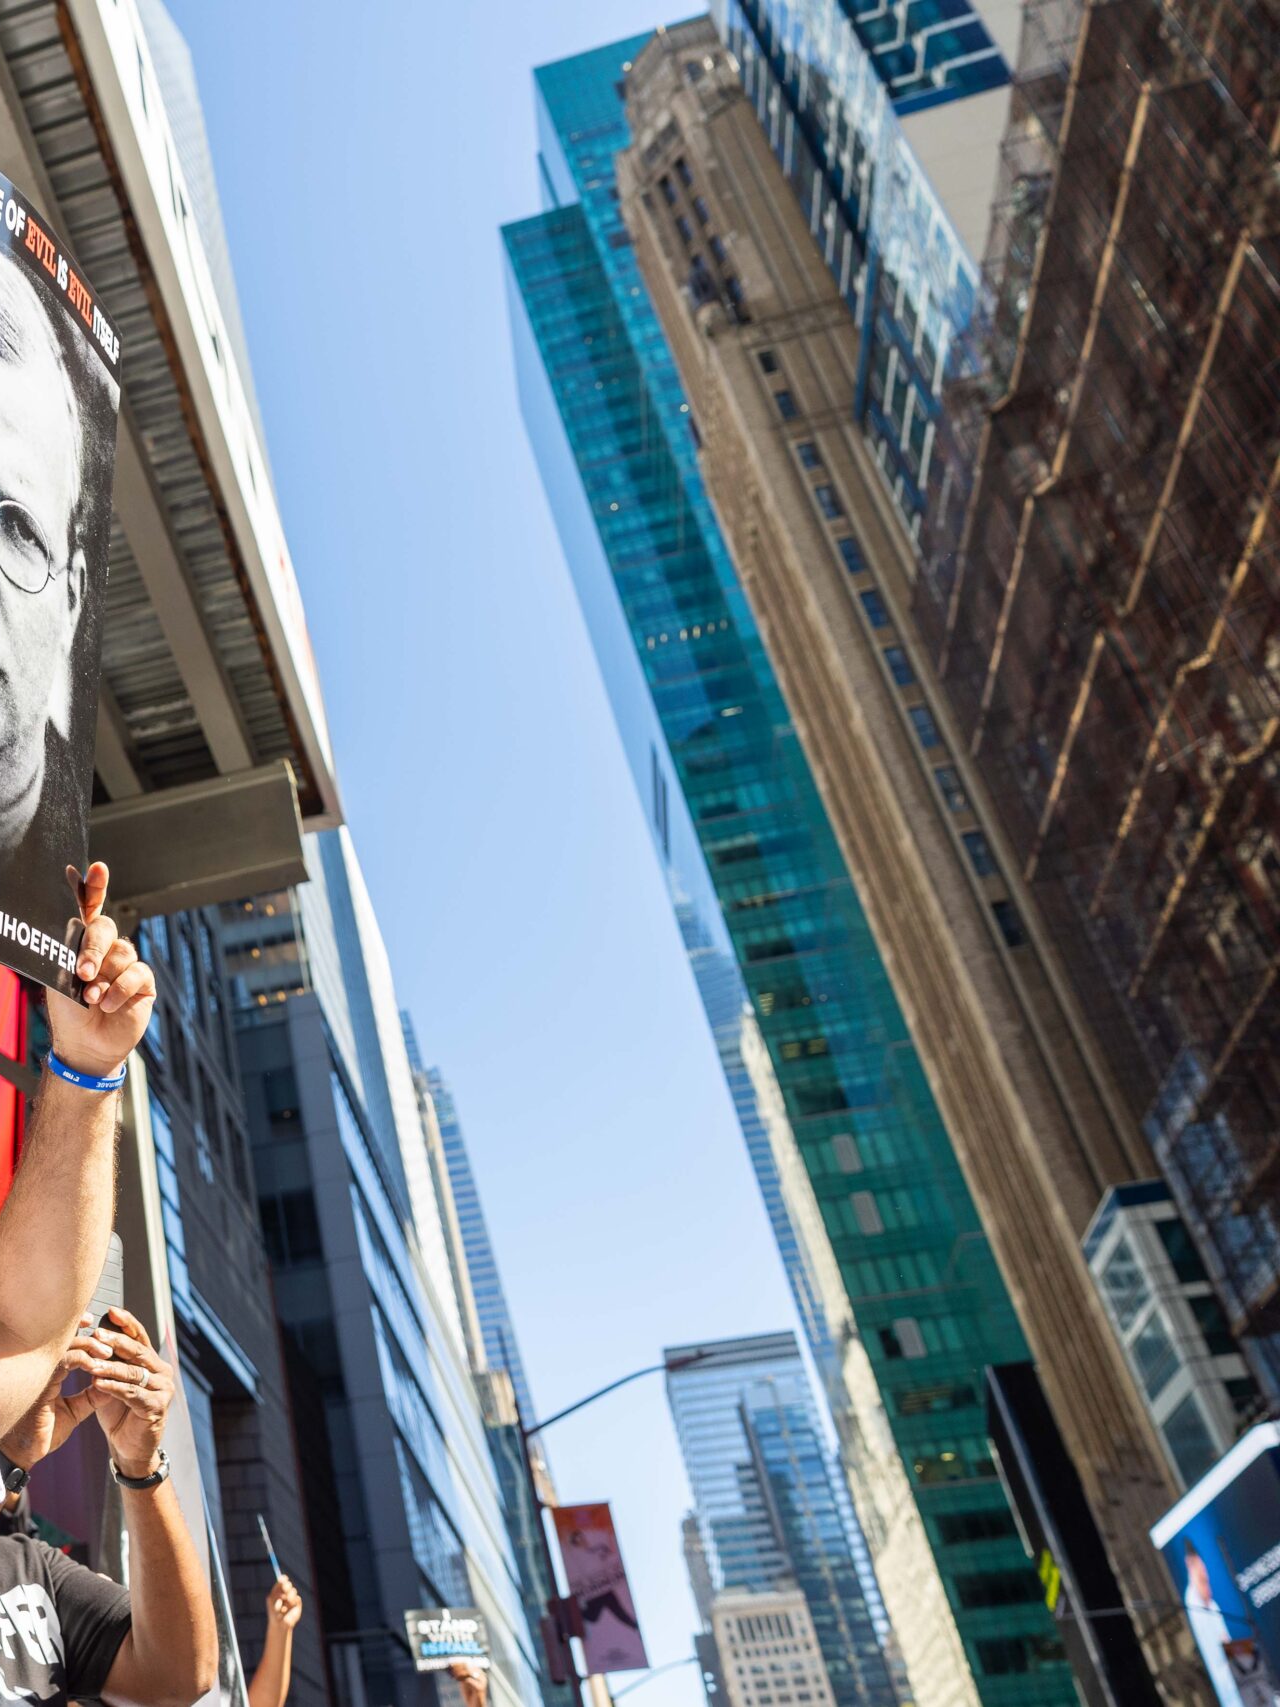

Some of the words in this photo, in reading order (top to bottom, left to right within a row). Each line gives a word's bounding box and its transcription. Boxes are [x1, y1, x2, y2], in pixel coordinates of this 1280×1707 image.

[5, 199, 26, 238] OF
[25, 217, 57, 278] EVIL
[57, 254, 68, 291] IS
[68, 269, 93, 328] EVIL
[93, 305, 120, 366] ITSELF
